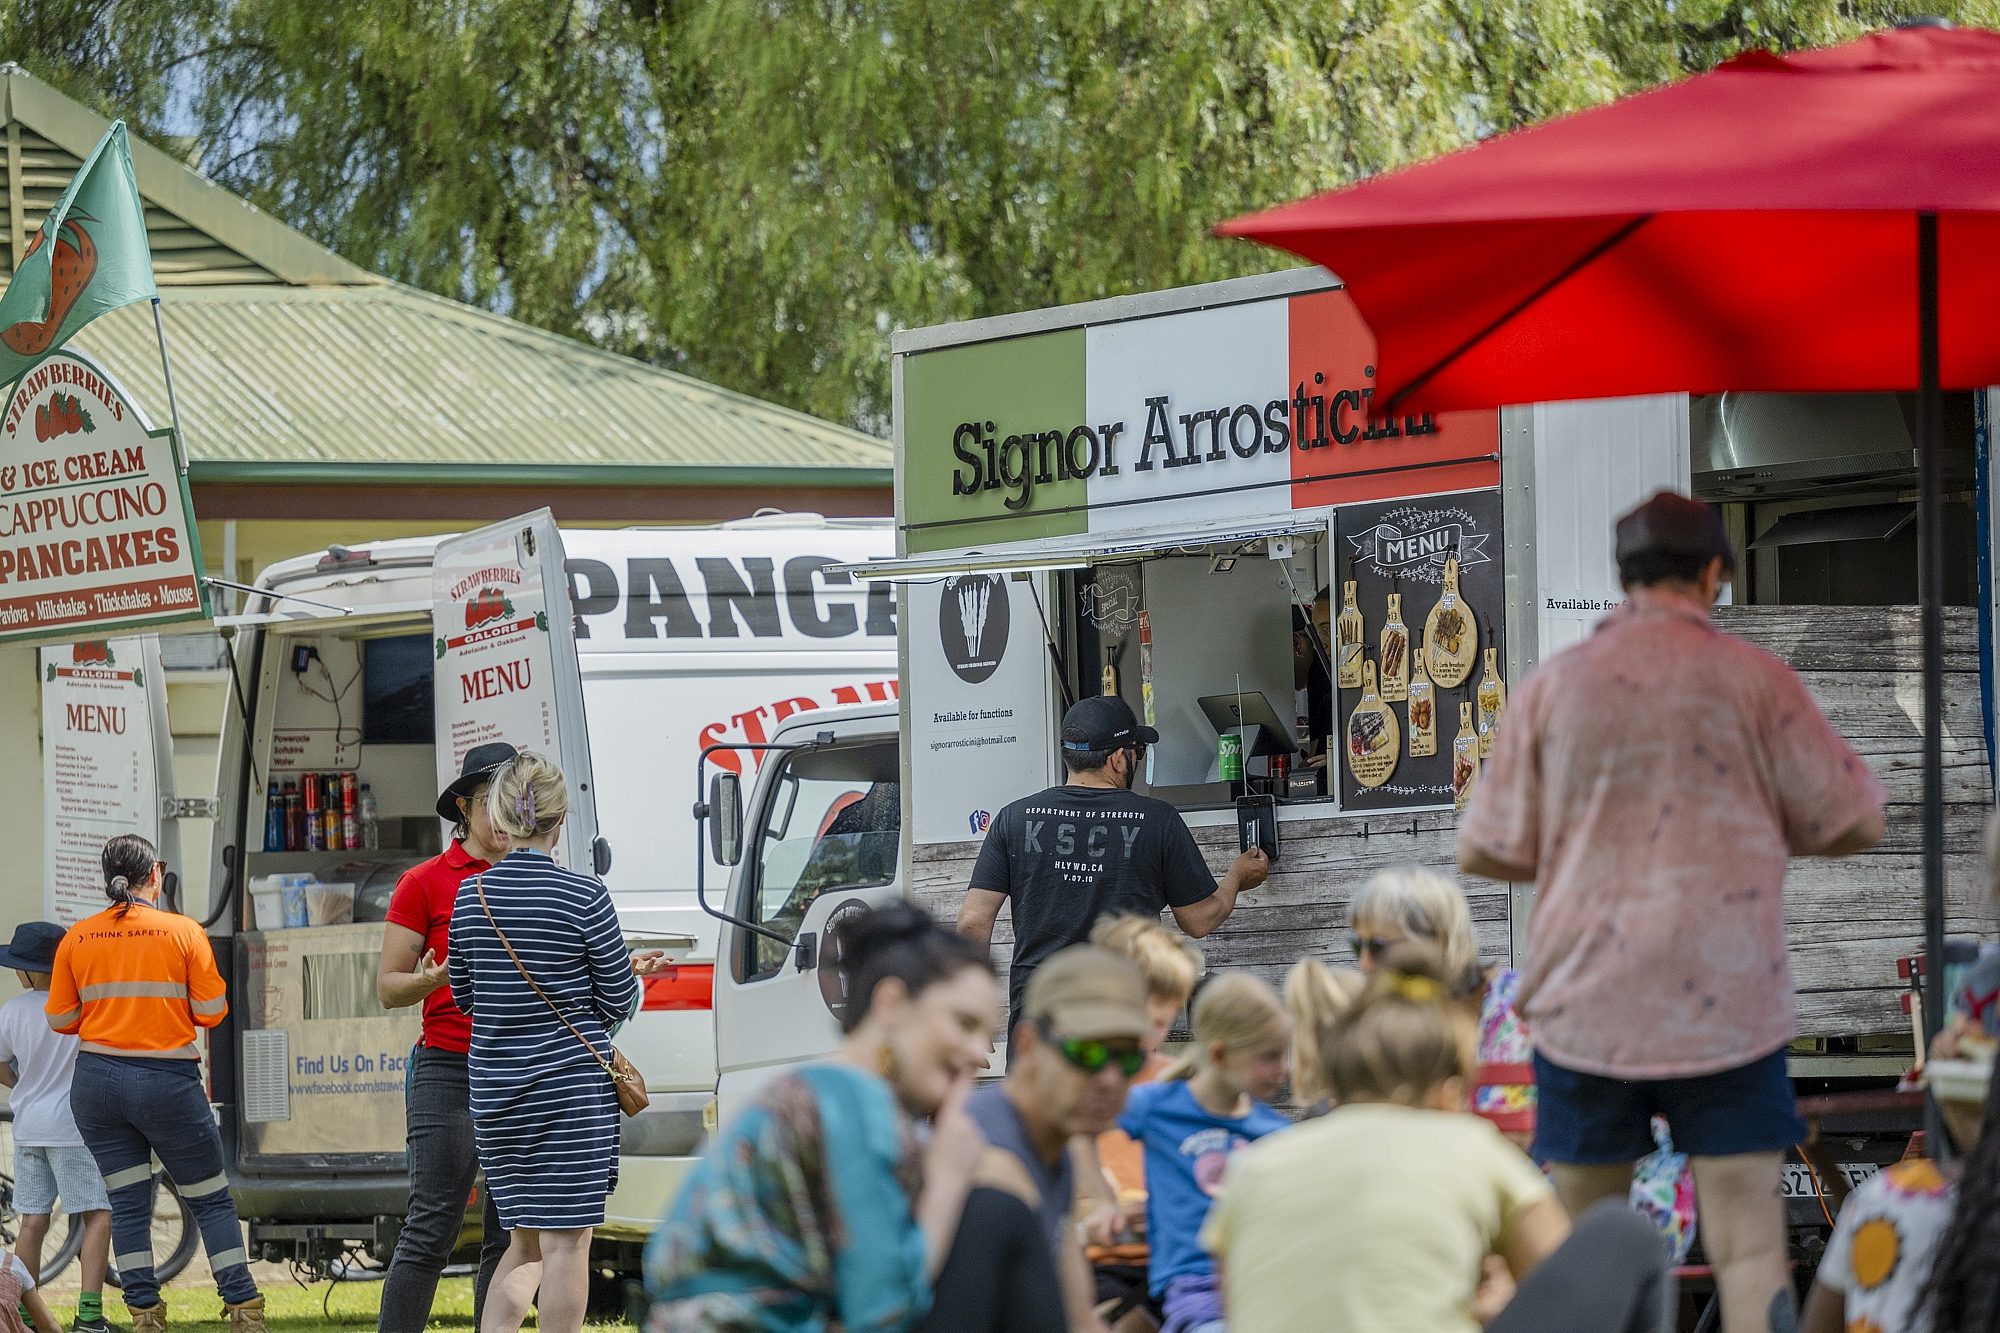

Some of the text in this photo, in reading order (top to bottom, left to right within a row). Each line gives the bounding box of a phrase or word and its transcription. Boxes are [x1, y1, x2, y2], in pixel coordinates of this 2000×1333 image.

[6, 363, 124, 440] STRAWBERRIES
[952, 369, 1437, 510] Signor Arrostici
[1, 446, 146, 491] & ICE CREAM
[0, 527, 180, 585] PANCAKES
[1386, 530, 1449, 562] MENU
[451, 567, 521, 602] STRAWBERRIES
[0, 585, 194, 625] avlova Milkshakes Thickshakes Mousse
[1547, 598, 1600, 610] Available
[1603, 599, 1620, 610] for
[463, 623, 519, 645] GALORE
[461, 658, 532, 704] MENU
[66, 703, 127, 735] MENU
[933, 708, 1013, 723] Available for functions
[1025, 807, 1081, 818] DEPARTMENT
[1100, 811, 1145, 820] STRENGTH
[1054, 861, 1104, 872] HLYWD.CA
[90, 929, 169, 939] THINK SAFETY
[296, 1055, 325, 1075] Find
[330, 1054, 349, 1073] Us
[354, 1053, 374, 1073] On
